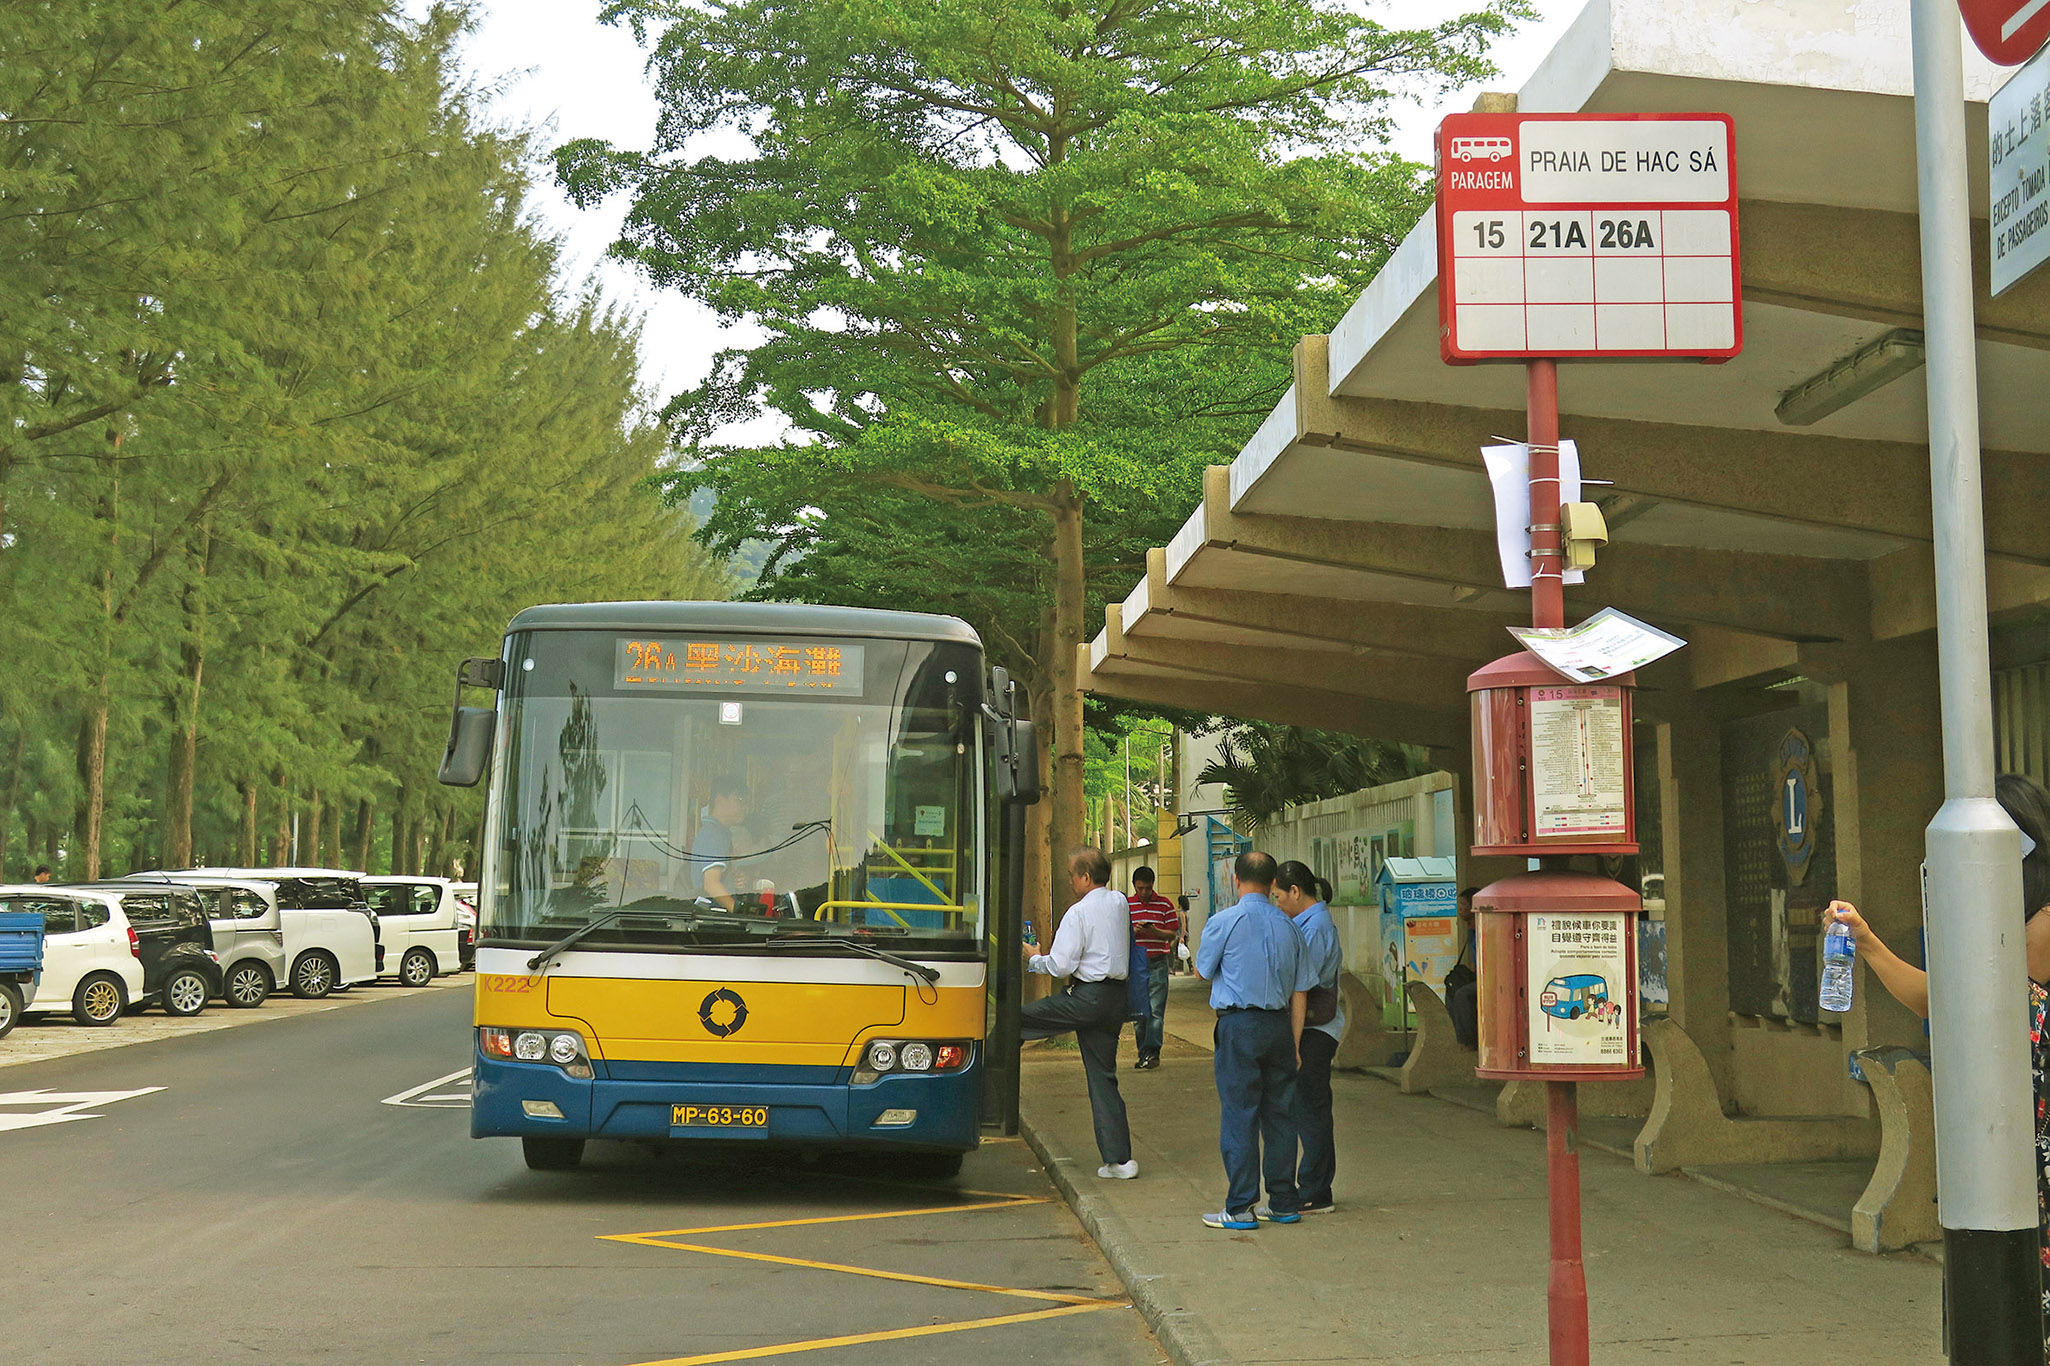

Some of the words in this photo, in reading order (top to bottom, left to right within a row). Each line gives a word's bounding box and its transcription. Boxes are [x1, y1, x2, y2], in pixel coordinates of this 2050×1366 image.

[1530, 150, 1591, 172] PRAIA
[1601, 150, 1627, 172] DE
[1636, 150, 1679, 172] HAC
[1689, 146, 1718, 172] SÁ
[1451, 171, 1513, 190] PARAGEM
[1993, 186, 2019, 229] EXCEPTO
[2022, 164, 2046, 206] TOMADA
[1473, 220, 1505, 249] 15
[1529, 220, 1587, 249] 21A
[1599, 219, 1655, 249] 26A
[1997, 233, 2006, 260] DE
[2008, 199, 2049, 253] PASSAGEIROS
[1549, 689, 1563, 700] 15
[1786, 778, 1804, 835] L
[484, 975, 530, 993] K222
[672, 1106, 767, 1126] MP-63-60
